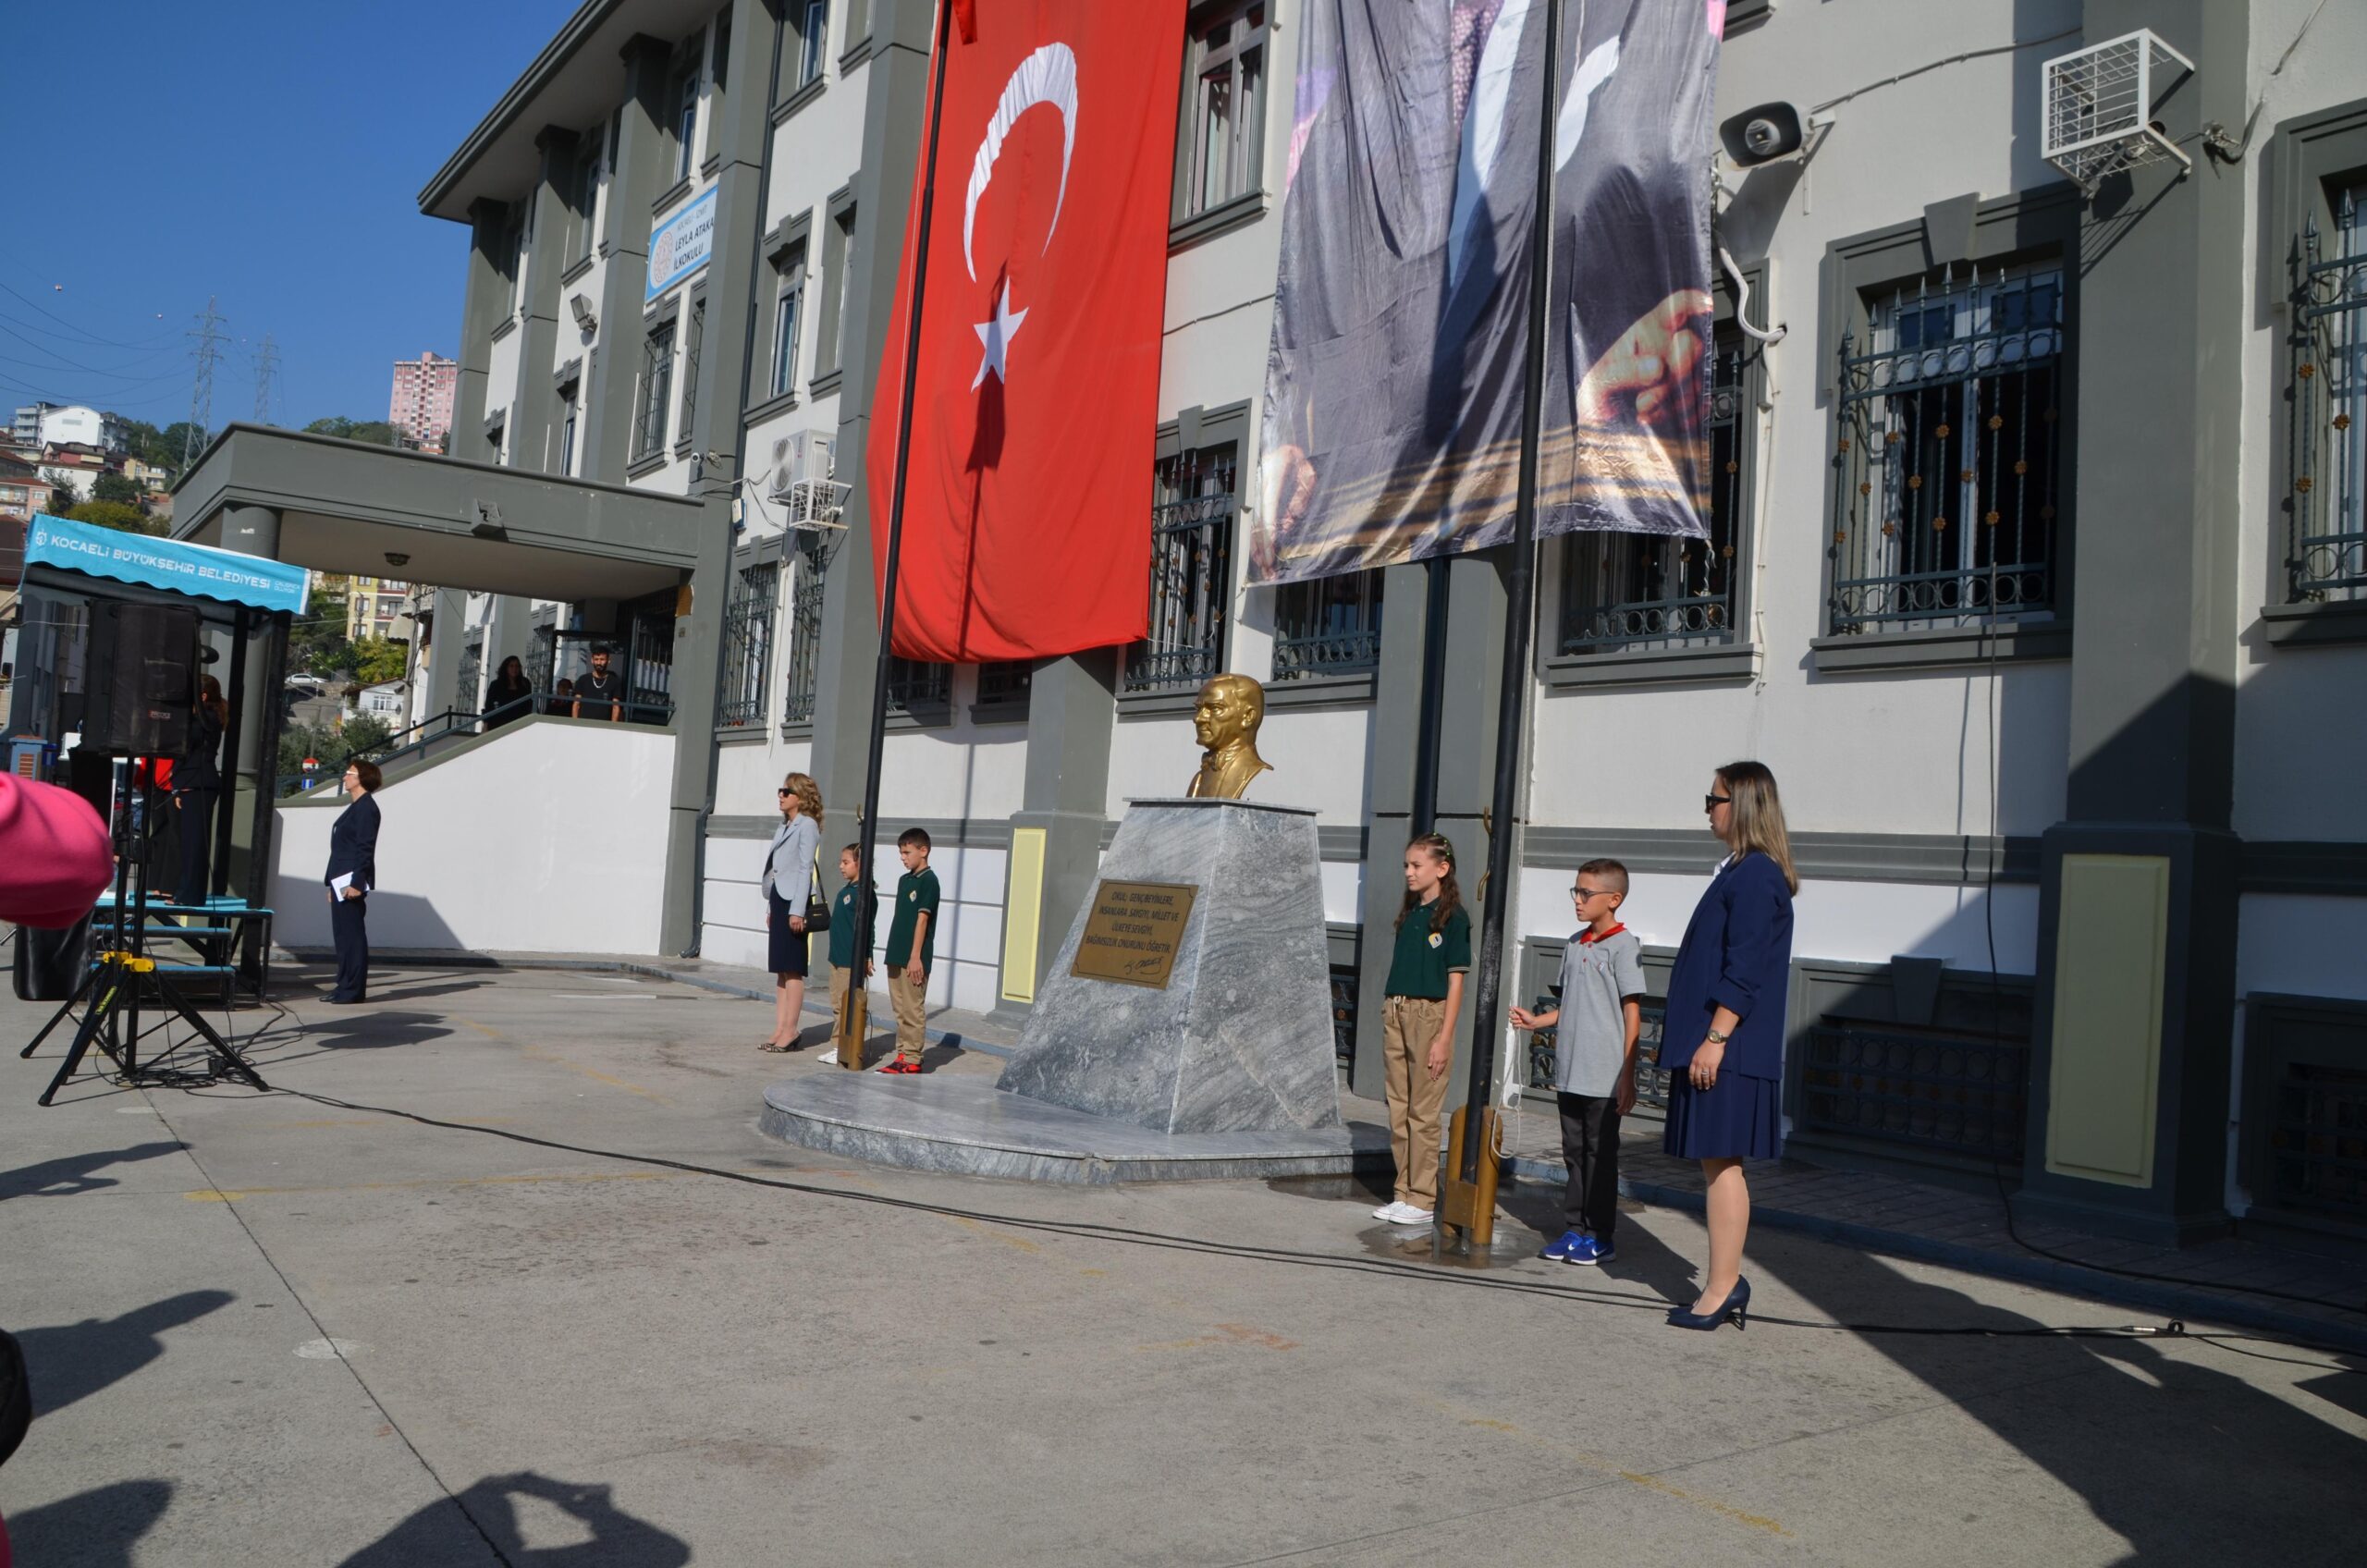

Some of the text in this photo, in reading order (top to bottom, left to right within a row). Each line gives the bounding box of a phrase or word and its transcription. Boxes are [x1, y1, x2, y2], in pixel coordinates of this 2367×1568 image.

[675, 216, 715, 252] LEYLA ATAKA
[673, 241, 704, 272] İLKOKULU
[52, 534, 271, 589] KOCAELİ BÜYÜKŞEHİR BELEDİYESİ
[1171, 912, 1180, 922] VE
